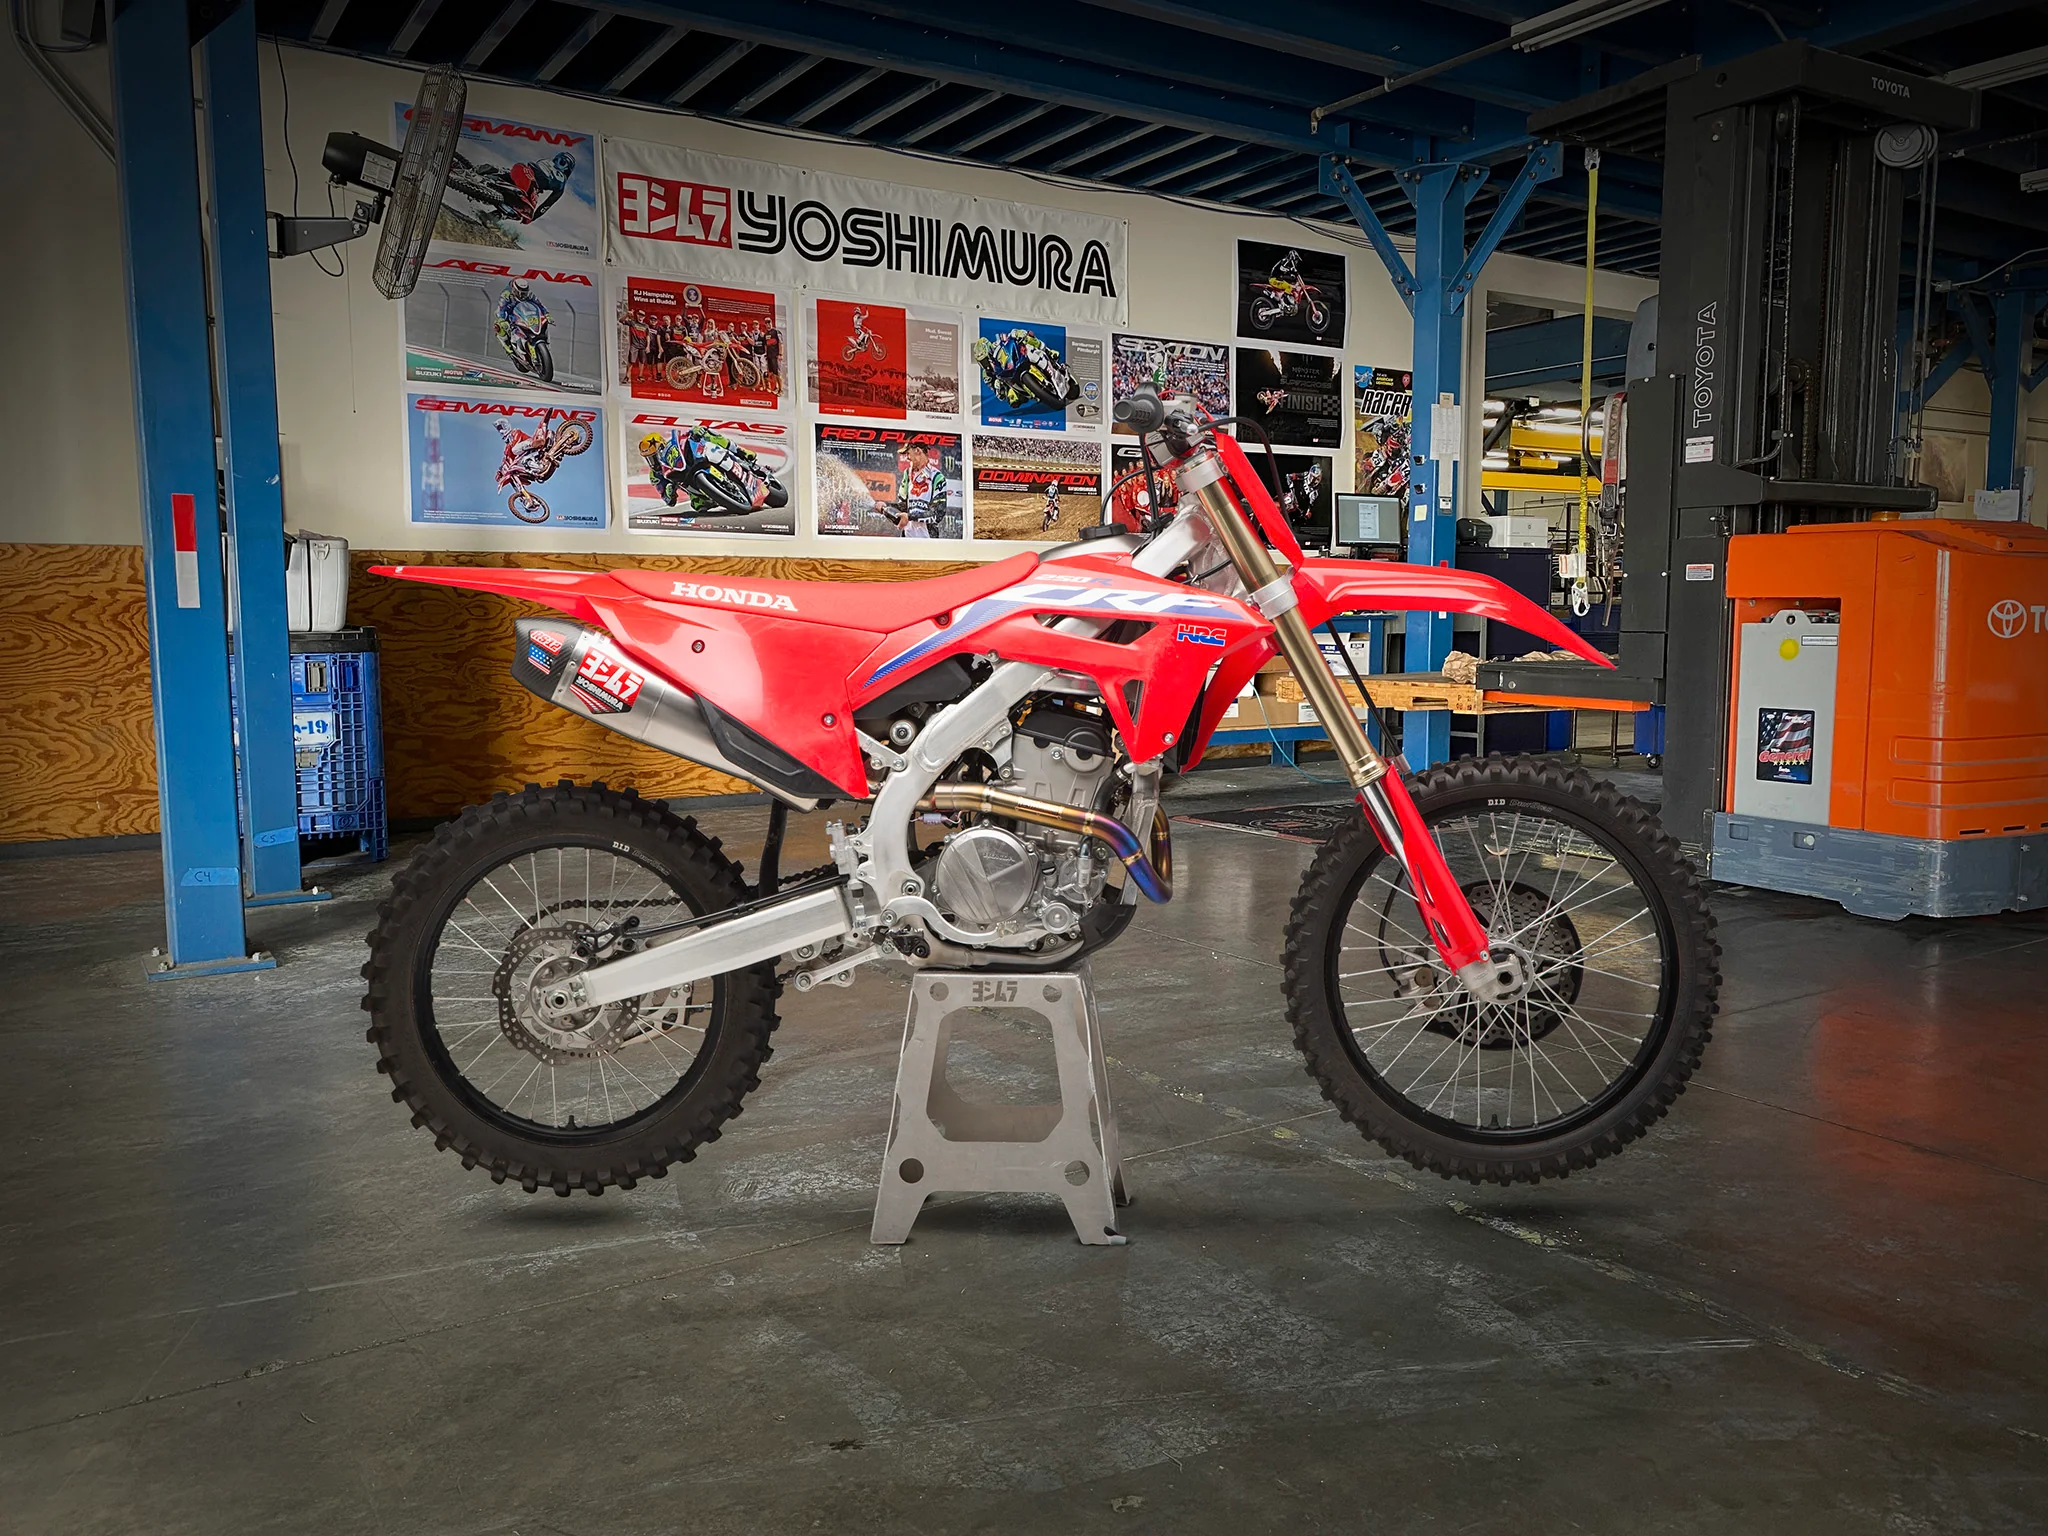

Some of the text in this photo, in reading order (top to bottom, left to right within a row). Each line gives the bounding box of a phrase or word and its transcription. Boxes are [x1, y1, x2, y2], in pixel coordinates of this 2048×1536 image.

[1871, 76, 1910, 98] TOYOTA
[738, 190, 1117, 298] YOSHIMURA
[415, 370, 442, 378] SUZUKI
[1693, 301, 1717, 429] TOYOTA
[414, 398, 597, 423] SEMARANG
[821, 427, 876, 442] RED
[880, 431, 957, 446] PLATE
[978, 469, 1098, 487] DOMINATION
[670, 581, 798, 612] HONDA
[1177, 624, 1227, 647] HRC
[575, 675, 624, 711] YOSHIMURA
[1759, 748, 1812, 763] General
[193, 871, 212, 883] C4
